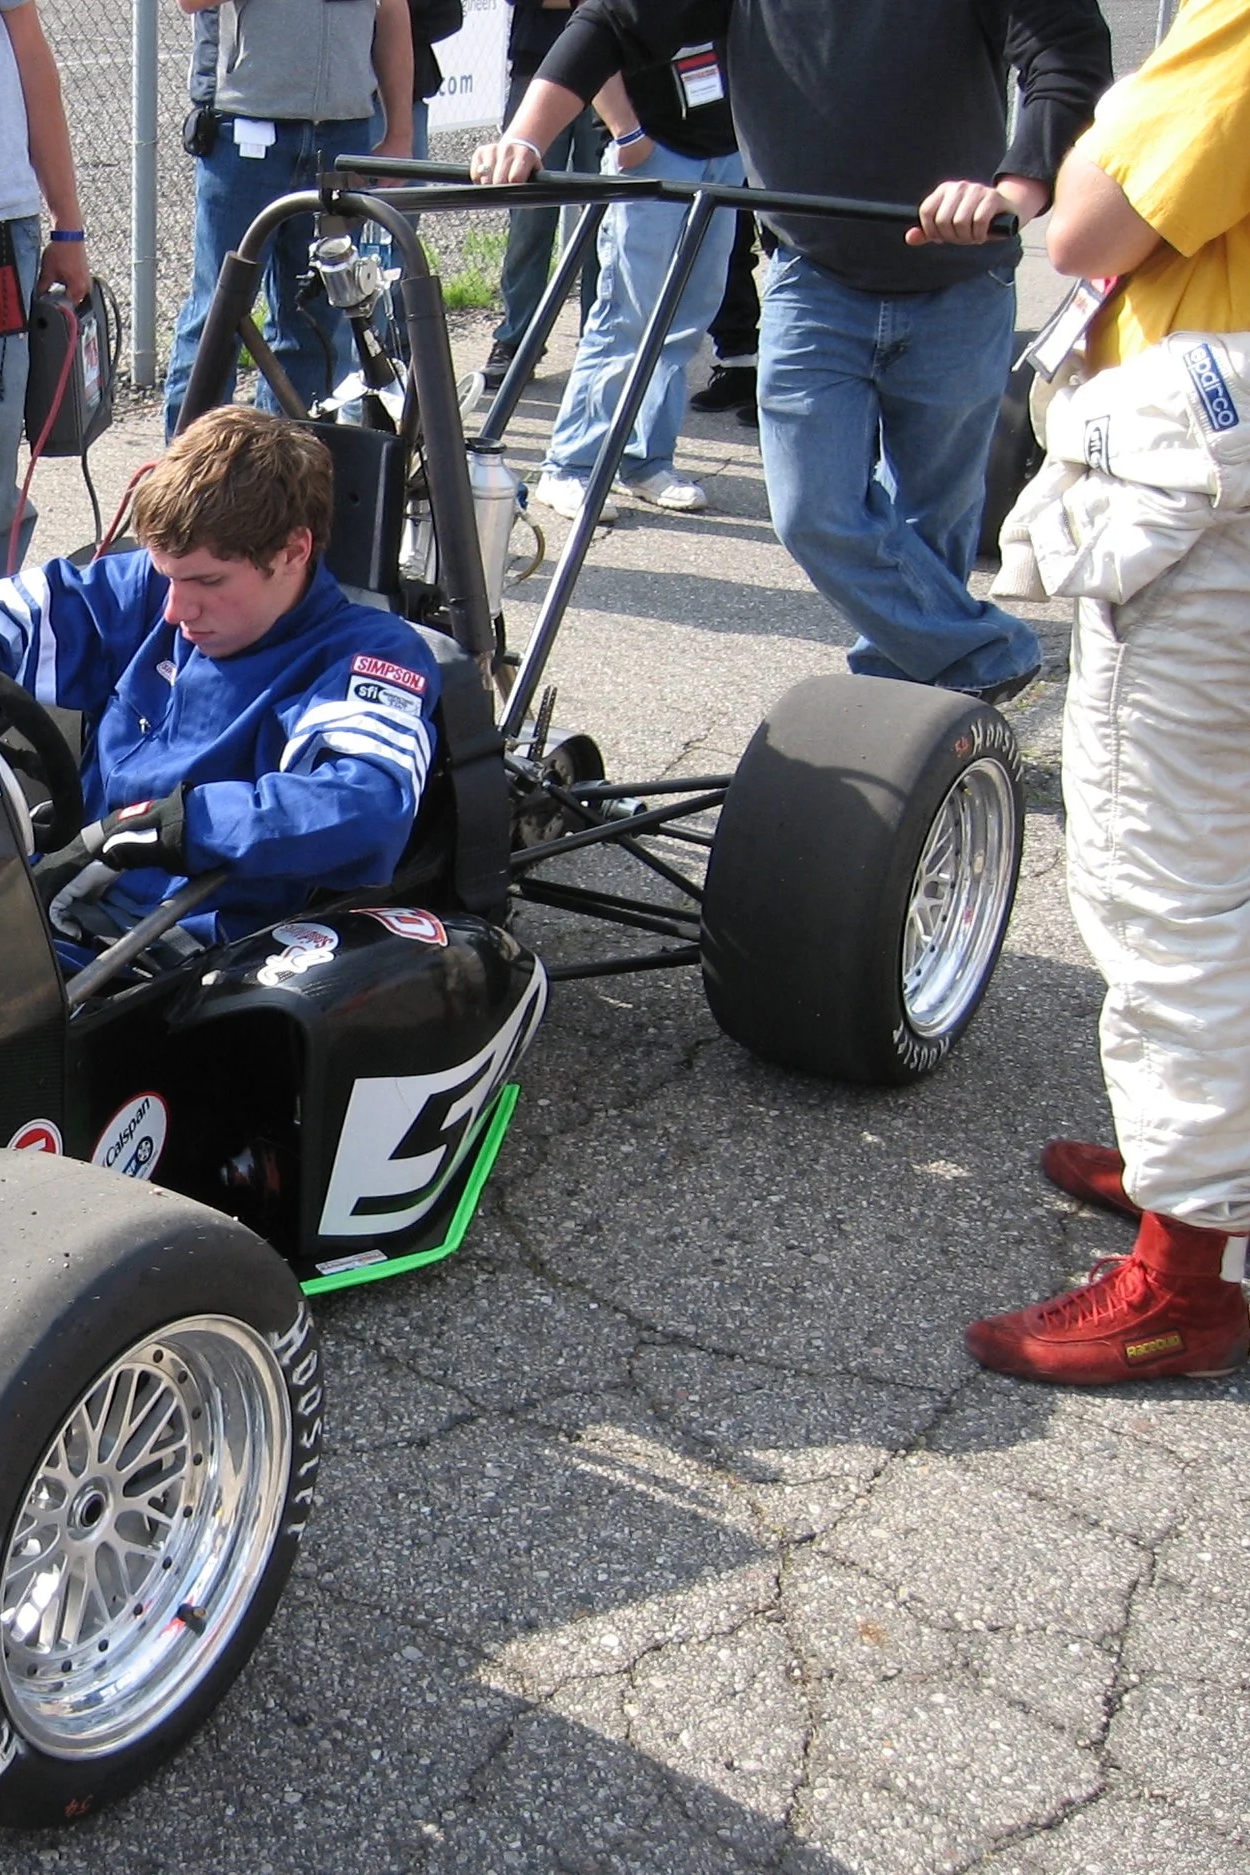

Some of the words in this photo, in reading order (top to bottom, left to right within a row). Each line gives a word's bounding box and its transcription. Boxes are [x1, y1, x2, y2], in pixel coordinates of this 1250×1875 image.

[1189, 347, 1235, 426] sparco
[357, 658, 422, 689] SIMPSON
[358, 685, 379, 700] sfi
[105, 1097, 151, 1168] Calspan
